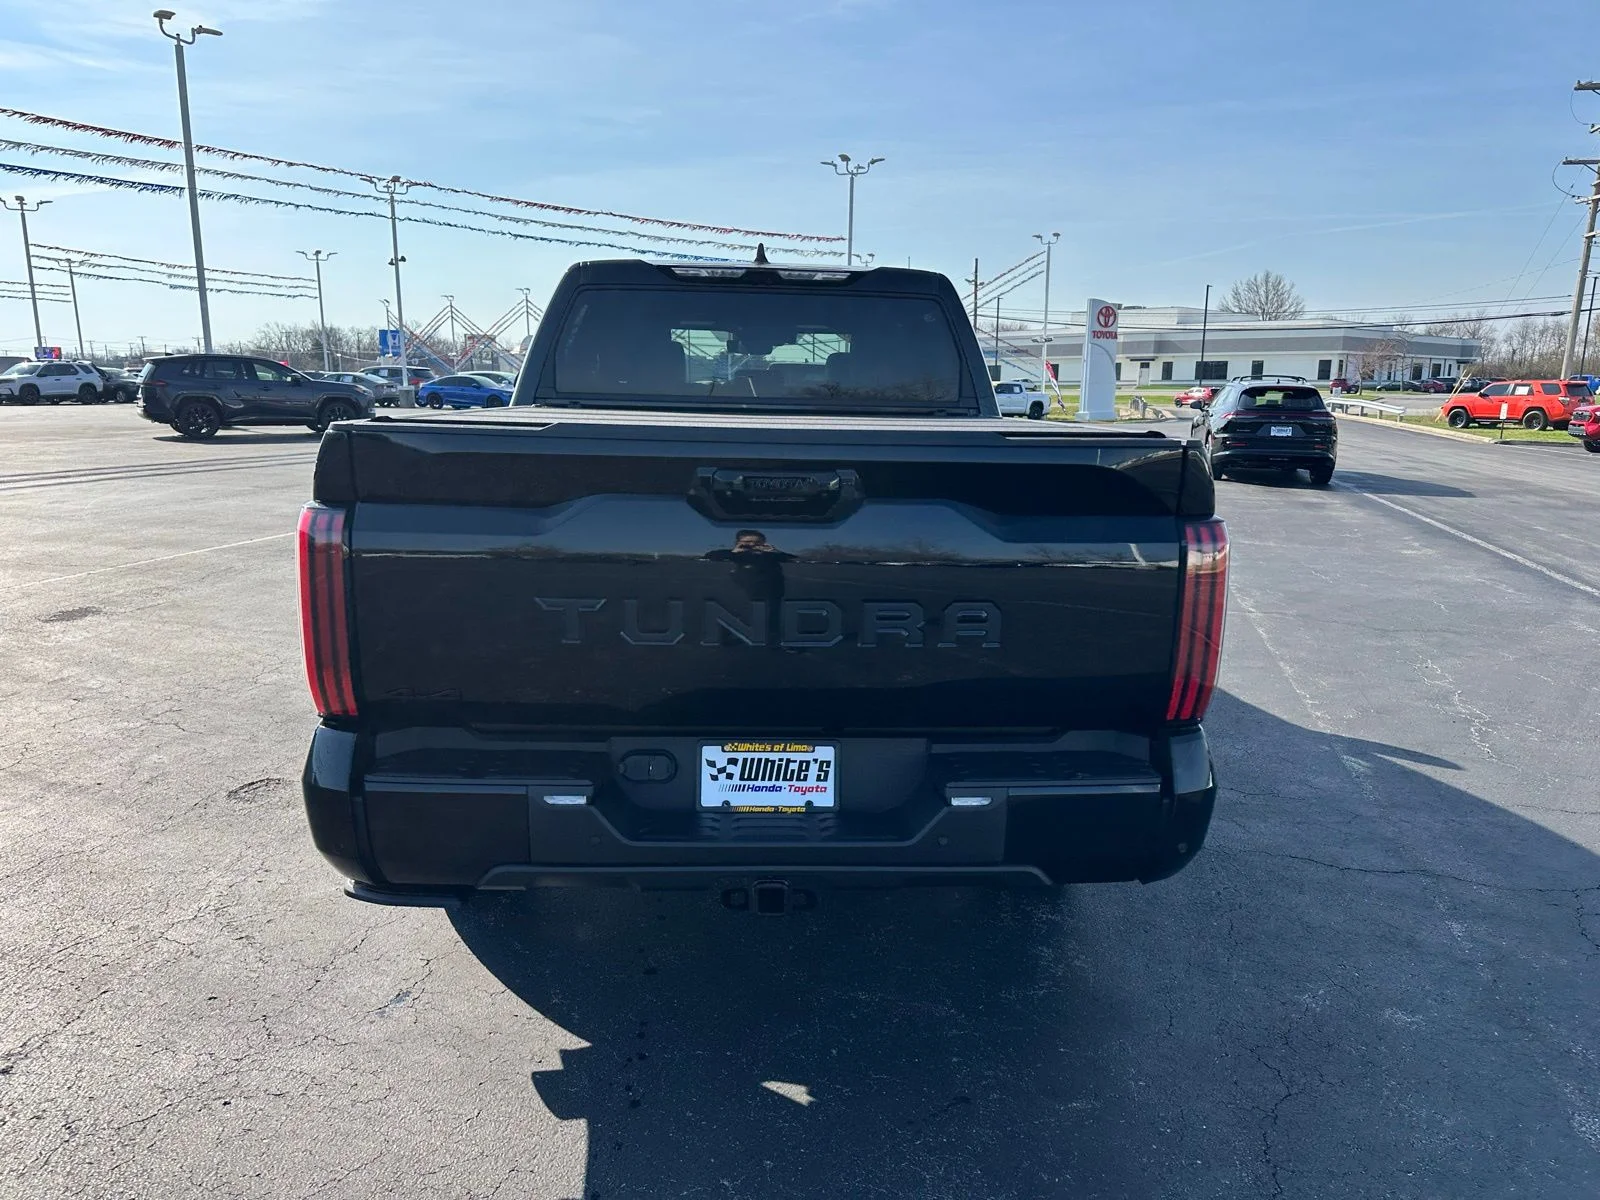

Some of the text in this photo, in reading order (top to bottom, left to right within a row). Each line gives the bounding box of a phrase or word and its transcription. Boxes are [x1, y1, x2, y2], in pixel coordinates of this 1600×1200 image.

[1092, 331, 1118, 339] TOYOTA
[533, 597, 1003, 648] TUNDRA
[738, 743, 771, 751] White's
[739, 758, 832, 782] White's
[746, 784, 827, 795] Honda Toyota
